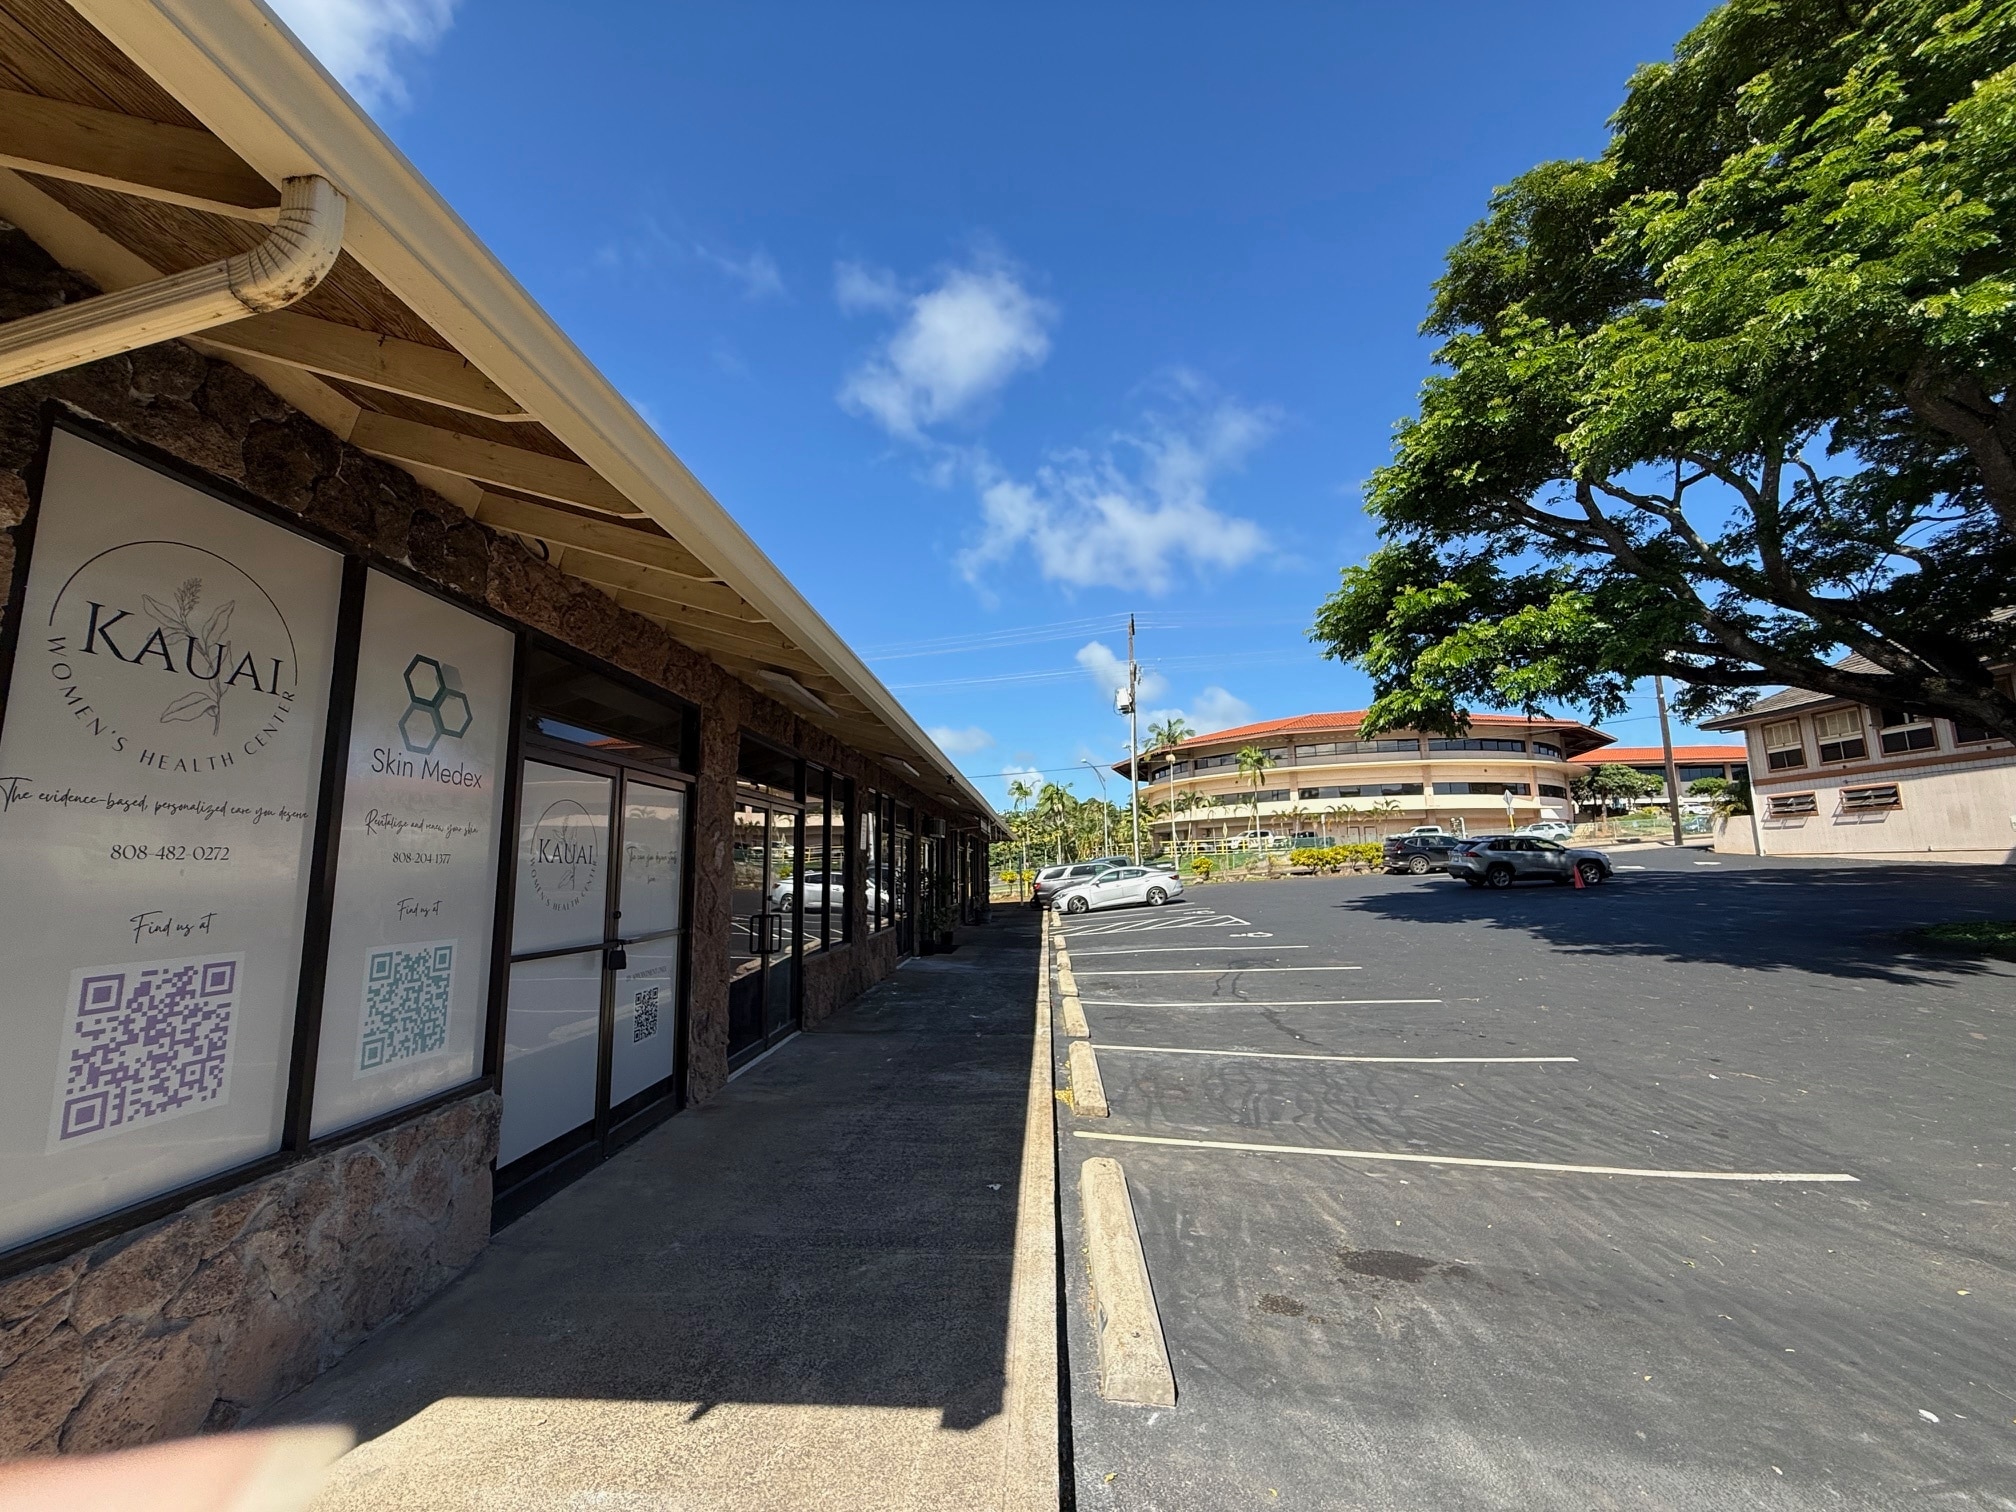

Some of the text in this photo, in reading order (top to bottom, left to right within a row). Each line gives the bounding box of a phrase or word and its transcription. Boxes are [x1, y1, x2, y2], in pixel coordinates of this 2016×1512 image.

[79, 600, 284, 696] KAUAI
[47, 636, 295, 773] WOMEN'S HEALTH CENTER
[371, 748, 482, 789] Skin Medex
[0, 777, 33, 812] The
[154, 800, 228, 821] personalized
[231, 806, 252, 815] care
[253, 806, 276, 825] you
[278, 806, 309, 822] deserve
[410, 818, 425, 832] and
[445, 824, 462, 839] your
[463, 821, 479, 837] skin
[110, 844, 230, 861] 808-482-0272
[537, 838, 593, 865] KAUAI
[397, 897, 443, 921] Find us at
[130, 910, 217, 943] Find us at
